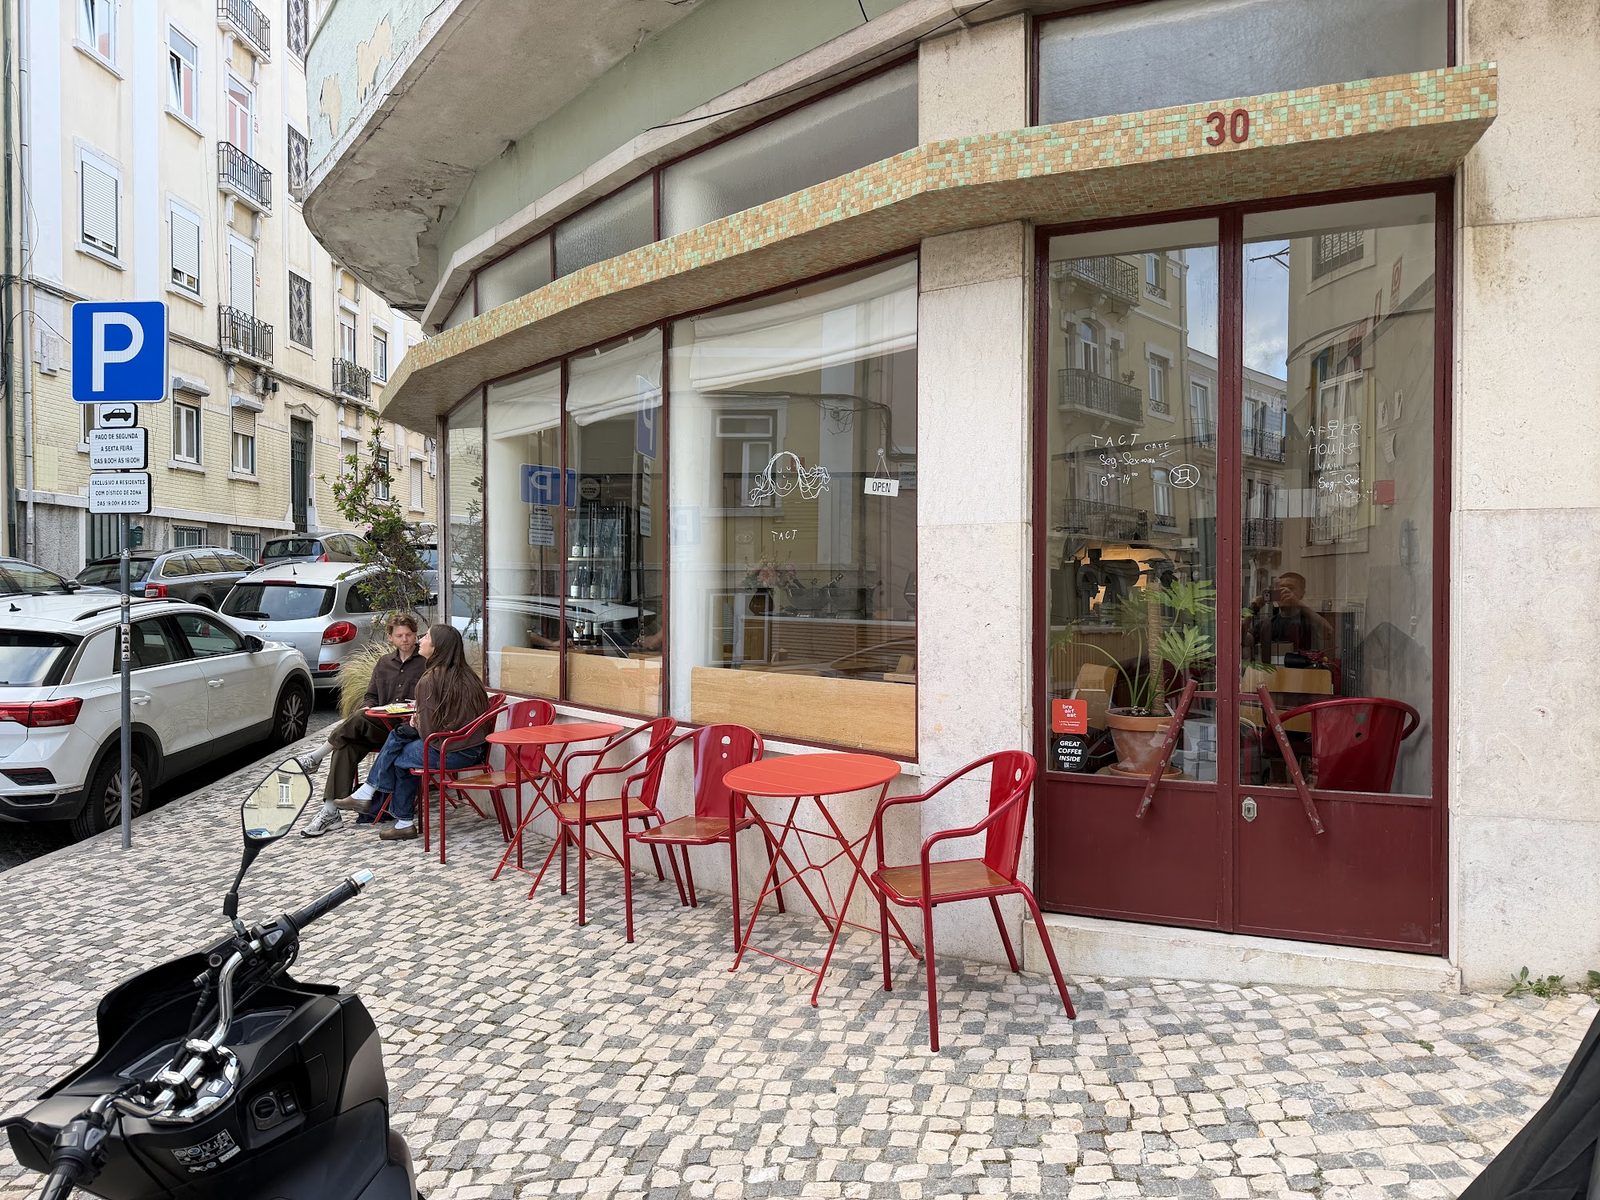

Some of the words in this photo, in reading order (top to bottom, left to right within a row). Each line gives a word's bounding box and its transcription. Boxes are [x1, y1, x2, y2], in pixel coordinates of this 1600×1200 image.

[1206, 109, 1249, 146] 30
[92, 311, 144, 392] P
[1091, 433, 1140, 448] TACT
[1308, 443, 1360, 455] HOURS
[872, 481, 891, 493] OPEN
[771, 530, 797, 541] TACT
[1057, 747, 1083, 755] COFFEE
[1058, 754, 1081, 762] INSIDE
